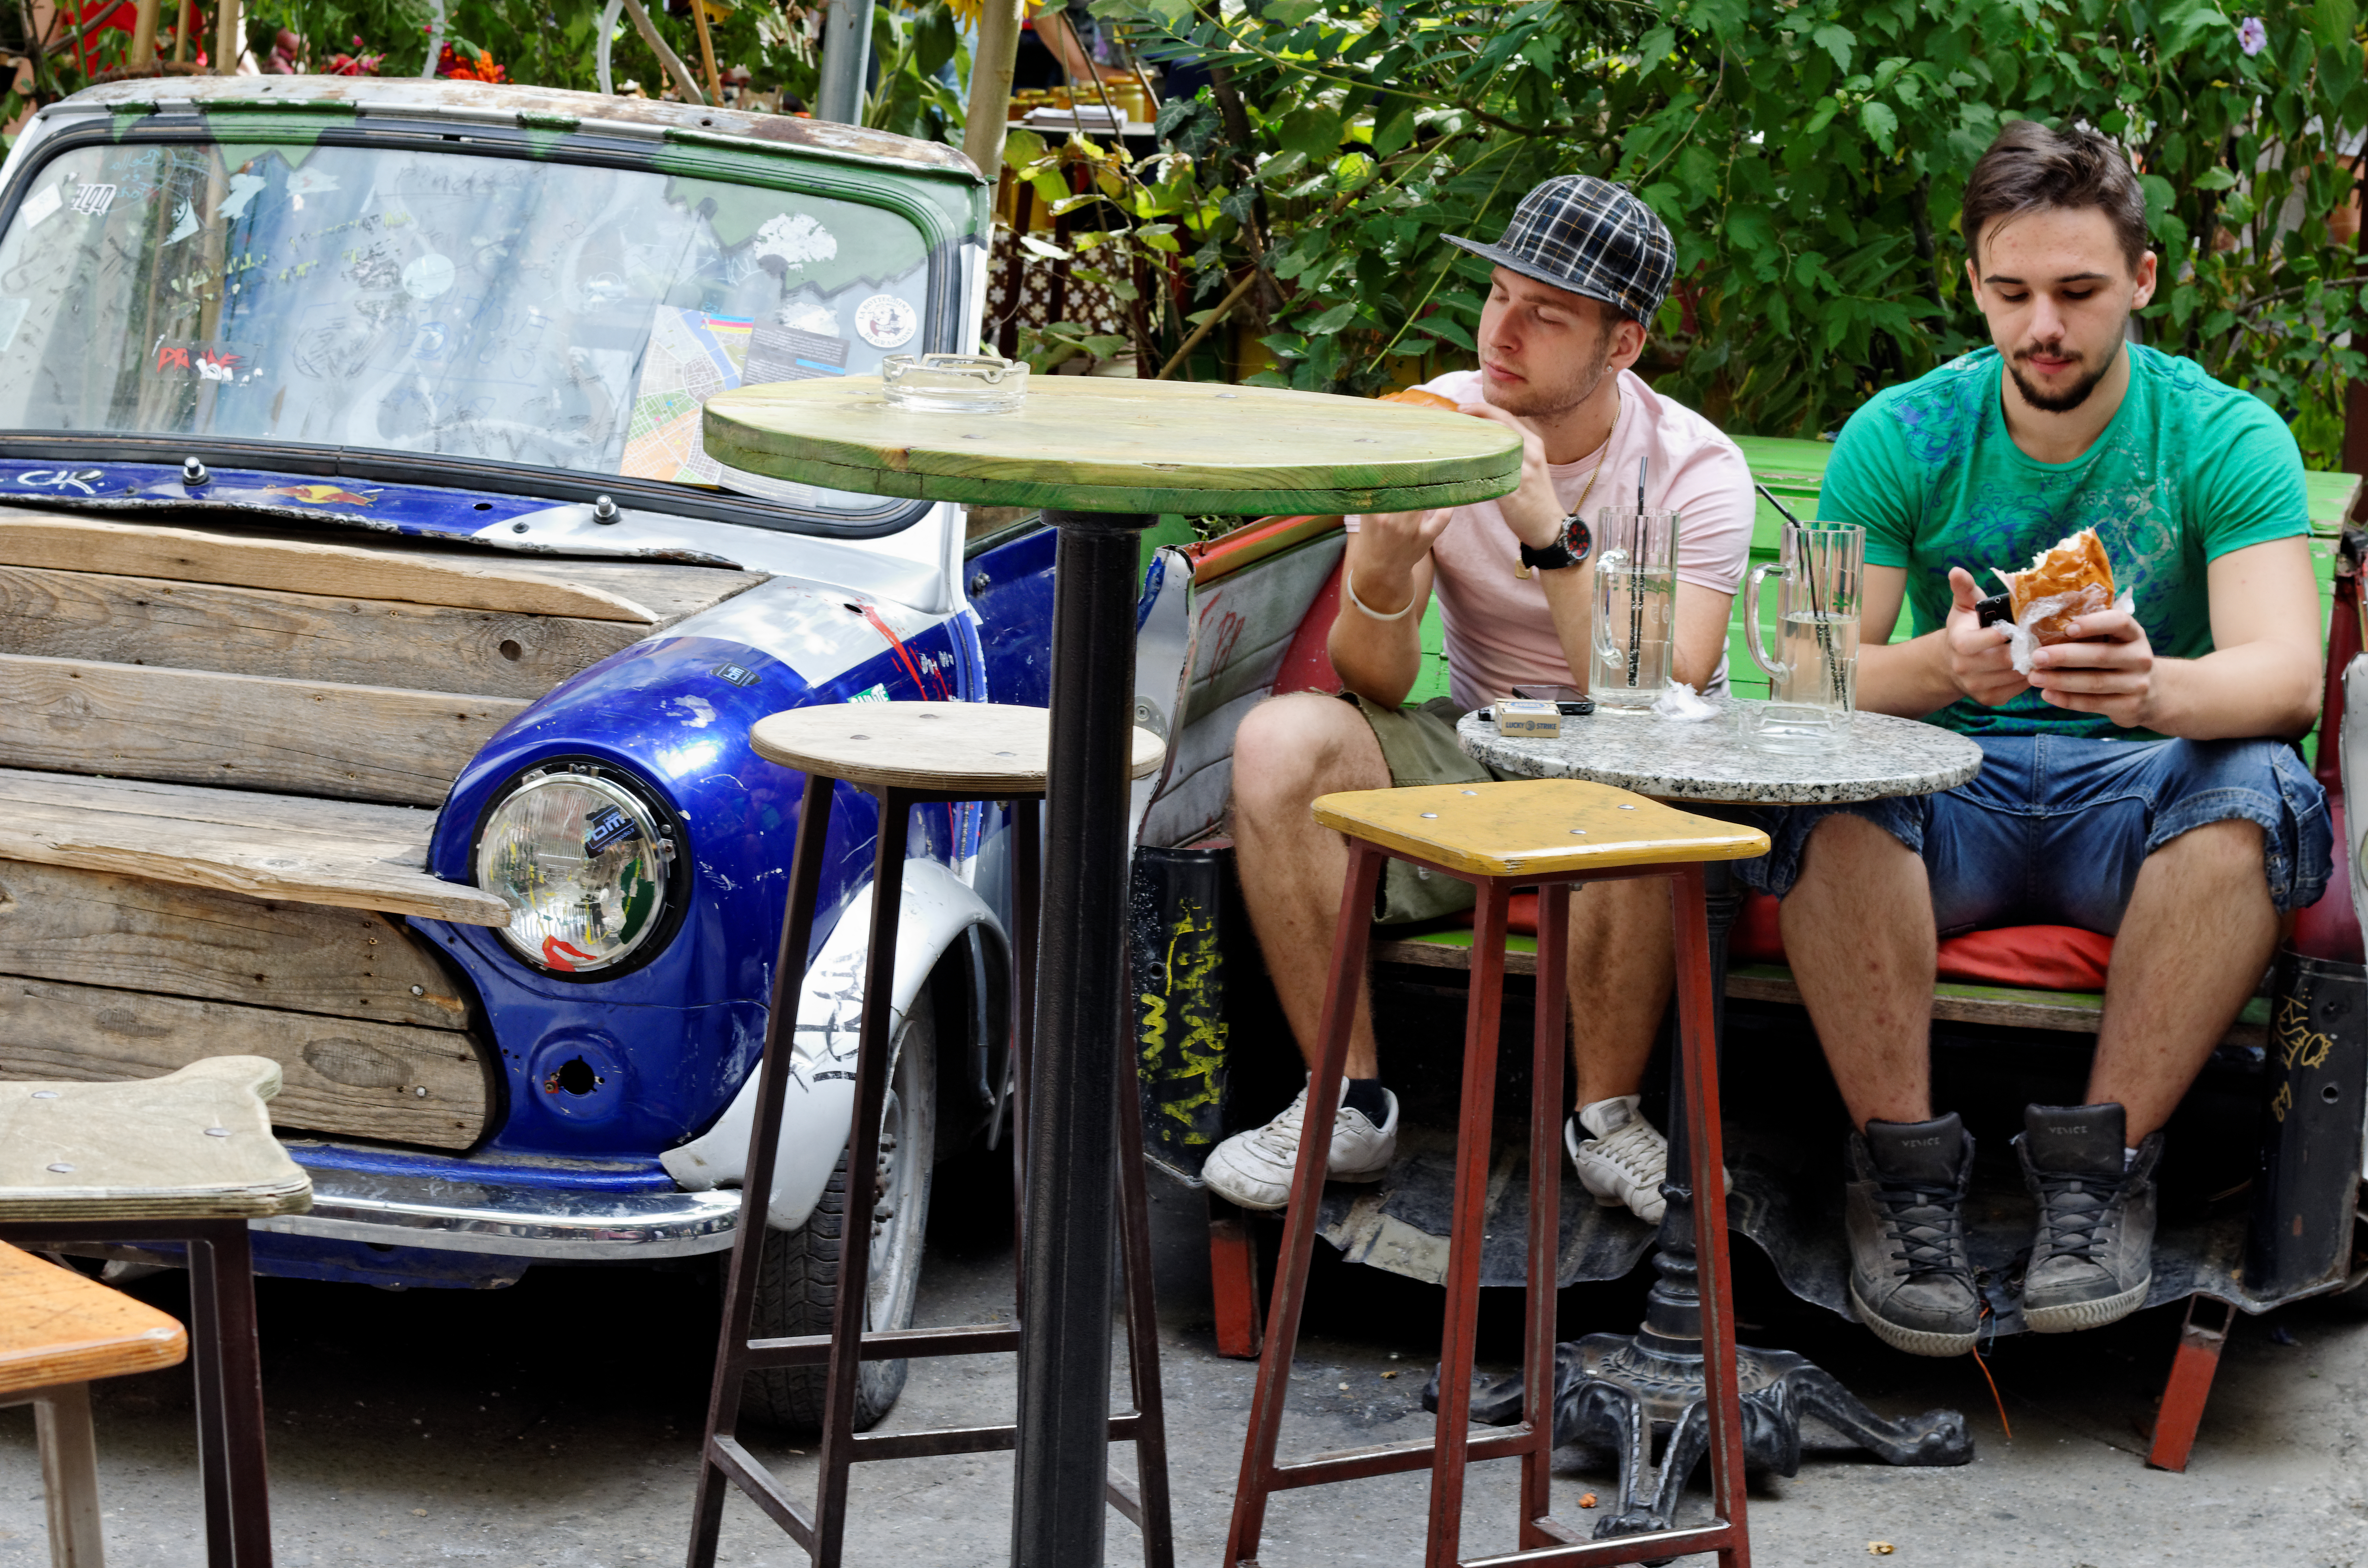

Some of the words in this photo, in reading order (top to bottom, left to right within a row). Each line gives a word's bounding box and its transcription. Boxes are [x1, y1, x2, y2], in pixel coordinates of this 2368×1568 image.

[874, 327, 913, 346] GRAGNONE
[2048, 1126, 2088, 1135] VENICE
[1901, 1137, 1940, 1148] VENICE
